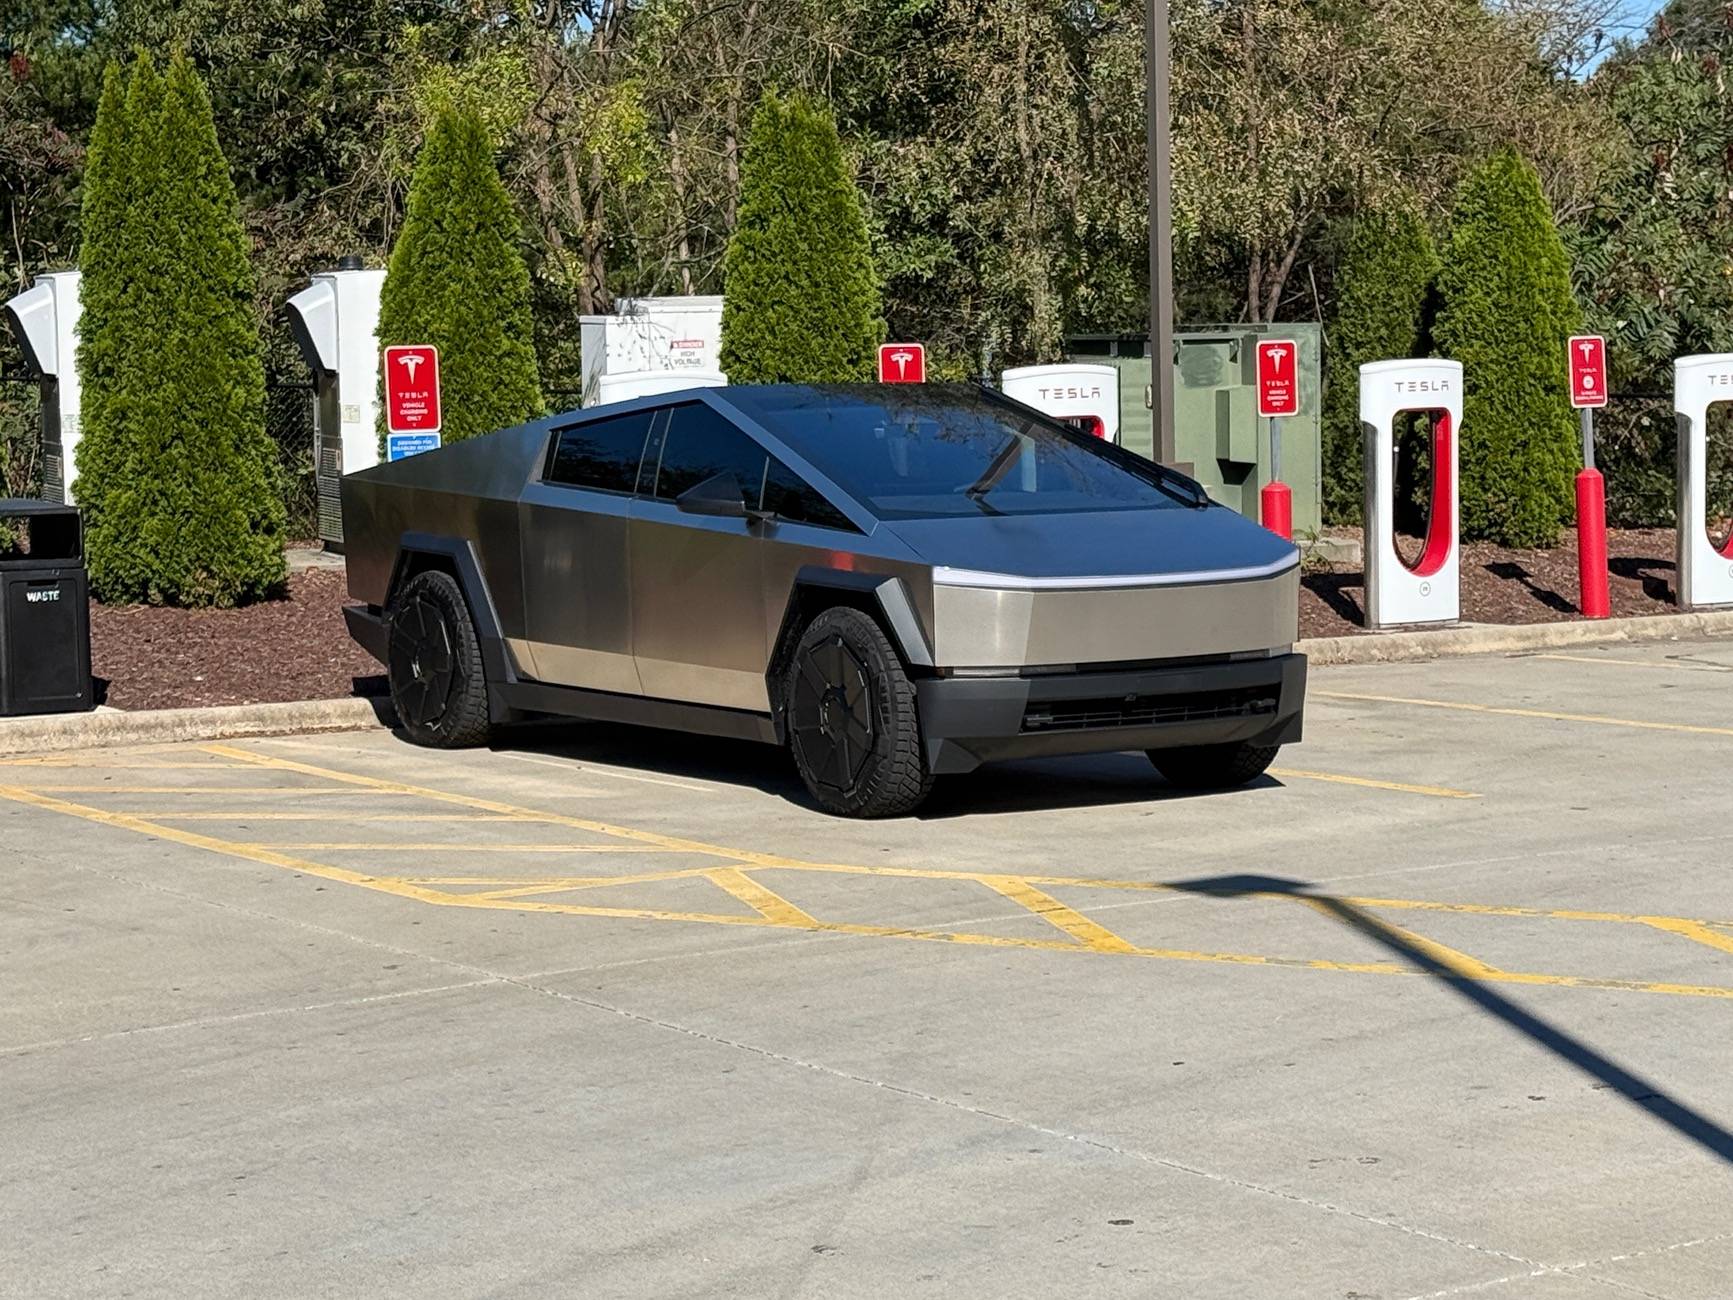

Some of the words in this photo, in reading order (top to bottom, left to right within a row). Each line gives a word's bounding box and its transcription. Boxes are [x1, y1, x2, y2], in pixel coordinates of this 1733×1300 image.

[1394, 380, 1449, 393] TESLA
[397, 391, 429, 399] TESLA
[1038, 387, 1101, 400] TESLA
[26, 590, 60, 602] WASTE
